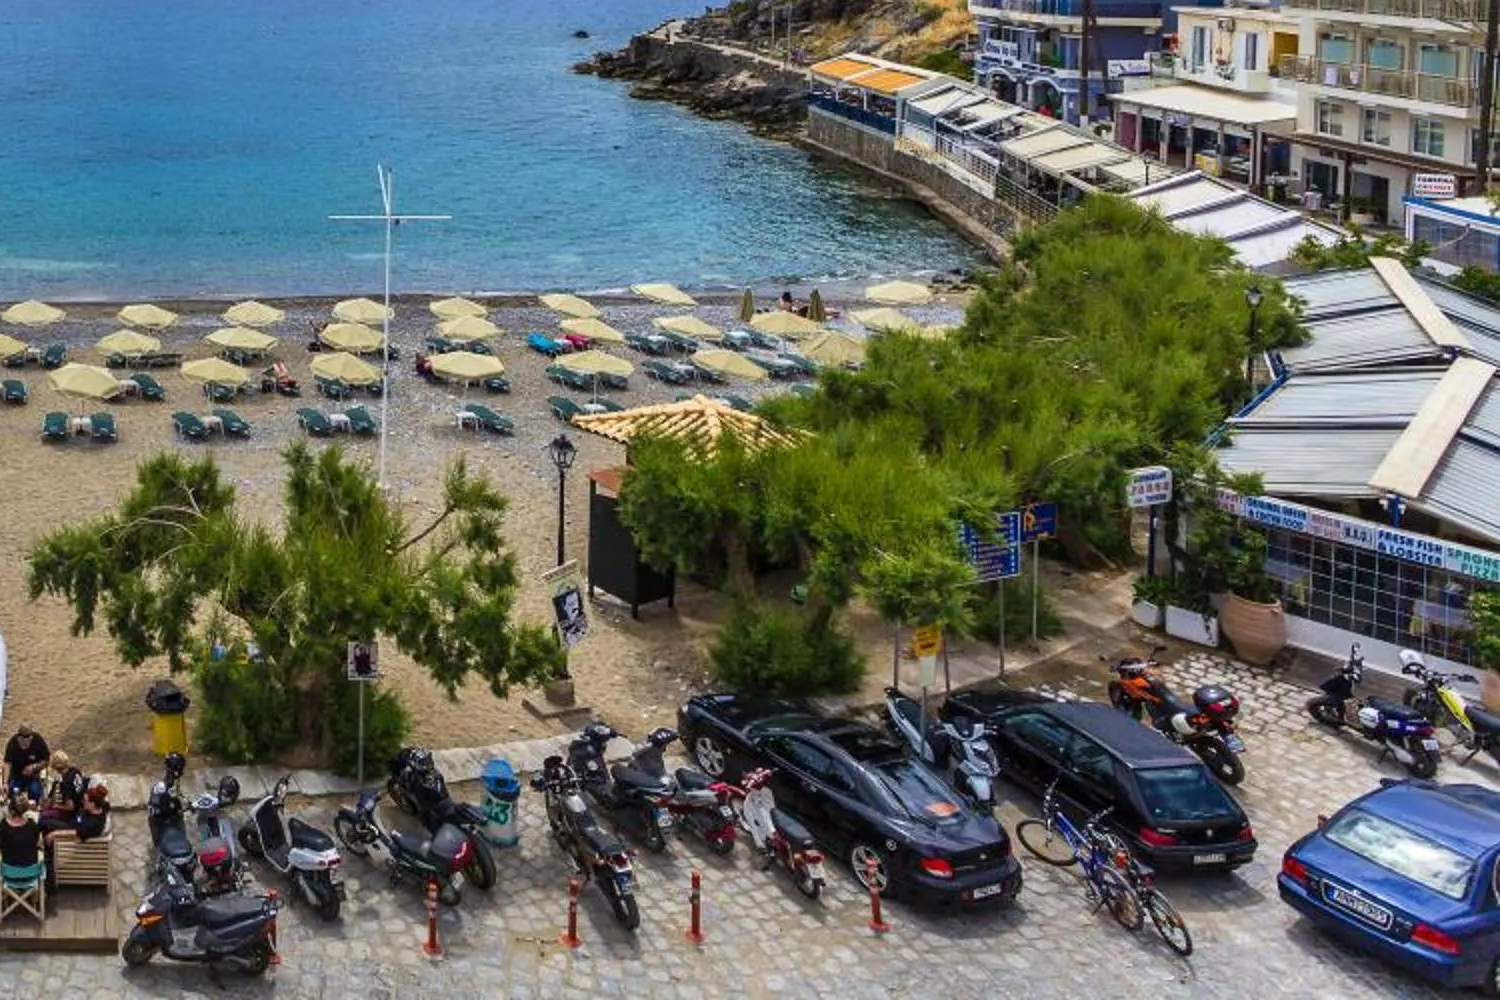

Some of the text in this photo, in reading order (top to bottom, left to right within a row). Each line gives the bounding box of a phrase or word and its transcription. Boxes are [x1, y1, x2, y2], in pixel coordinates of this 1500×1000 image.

[1378, 530, 1443, 554] FRESH FISH
[1389, 546, 1442, 566] LOBSTER
